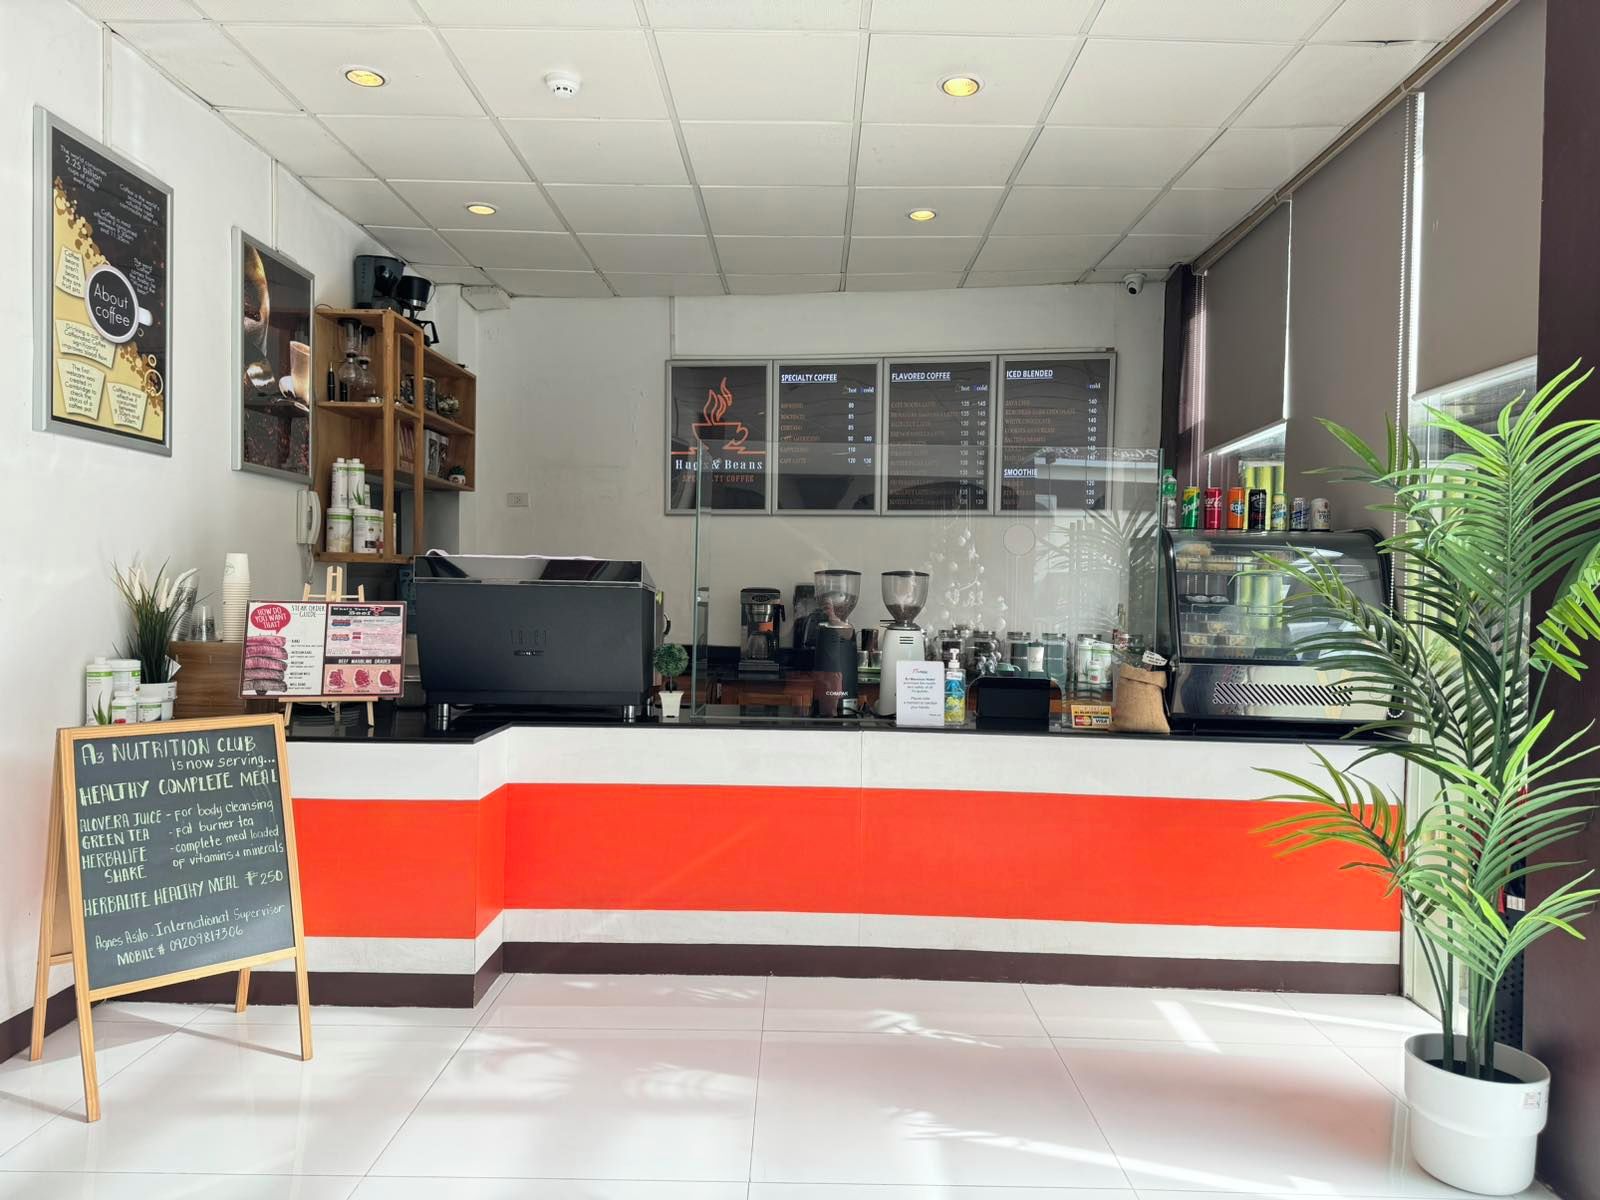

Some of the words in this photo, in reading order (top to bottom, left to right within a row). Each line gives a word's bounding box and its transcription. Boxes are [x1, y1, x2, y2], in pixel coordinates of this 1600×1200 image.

[65, 155, 81, 171] 2.25
[83, 164, 102, 183] billion
[64, 248, 79, 262] Coffee
[94, 282, 128, 309] About
[95, 306, 130, 327] coffee
[781, 374, 812, 382] SPECIALTY
[891, 372, 925, 380] FLAVORED
[926, 372, 951, 380] COFFEE
[1007, 370, 1021, 379] ICED
[1023, 370, 1053, 378] BLENDED
[712, 458, 721, 469] &
[725, 459, 763, 470] Beans
[255, 614, 269, 623] YOU
[269, 613, 288, 622] WANT
[257, 608, 272, 616] HOW
[112, 737, 210, 763] NUTRITION
[217, 736, 256, 753] CLUB
[171, 759, 184, 771] is
[185, 758, 214, 770] now
[219, 754, 276, 769] serving...
[79, 780, 150, 807] HEALTHY
[158, 772, 233, 796] COMPLETE
[239, 768, 278, 787] MEAL
[80, 812, 130, 833] ALOVERA
[133, 810, 162, 826] JUICE
[197, 803, 224, 820] body
[225, 799, 274, 814] cleansing
[81, 833, 125, 850] GREEN
[127, 829, 151, 842] TEA
[199, 818, 234, 832] burner
[238, 815, 254, 827] tea
[226, 829, 247, 843] meal
[251, 824, 279, 840] loaded
[82, 846, 148, 870] HERBALIFE
[190, 850, 233, 865] vitamins
[243, 839, 284, 857] minerals
[104, 865, 147, 884] SHAKE
[83, 891, 151, 918] HERBALIFE
[154, 877, 204, 906] HEALTHY
[208, 874, 239, 894] MEAL
[95, 935, 124, 952] Agnes
[155, 908, 230, 937] International
[233, 903, 286, 922] Supervisor
[117, 946, 155, 967] MOBILE
[158, 943, 166, 955] #
[169, 925, 244, 952] 09209817306
